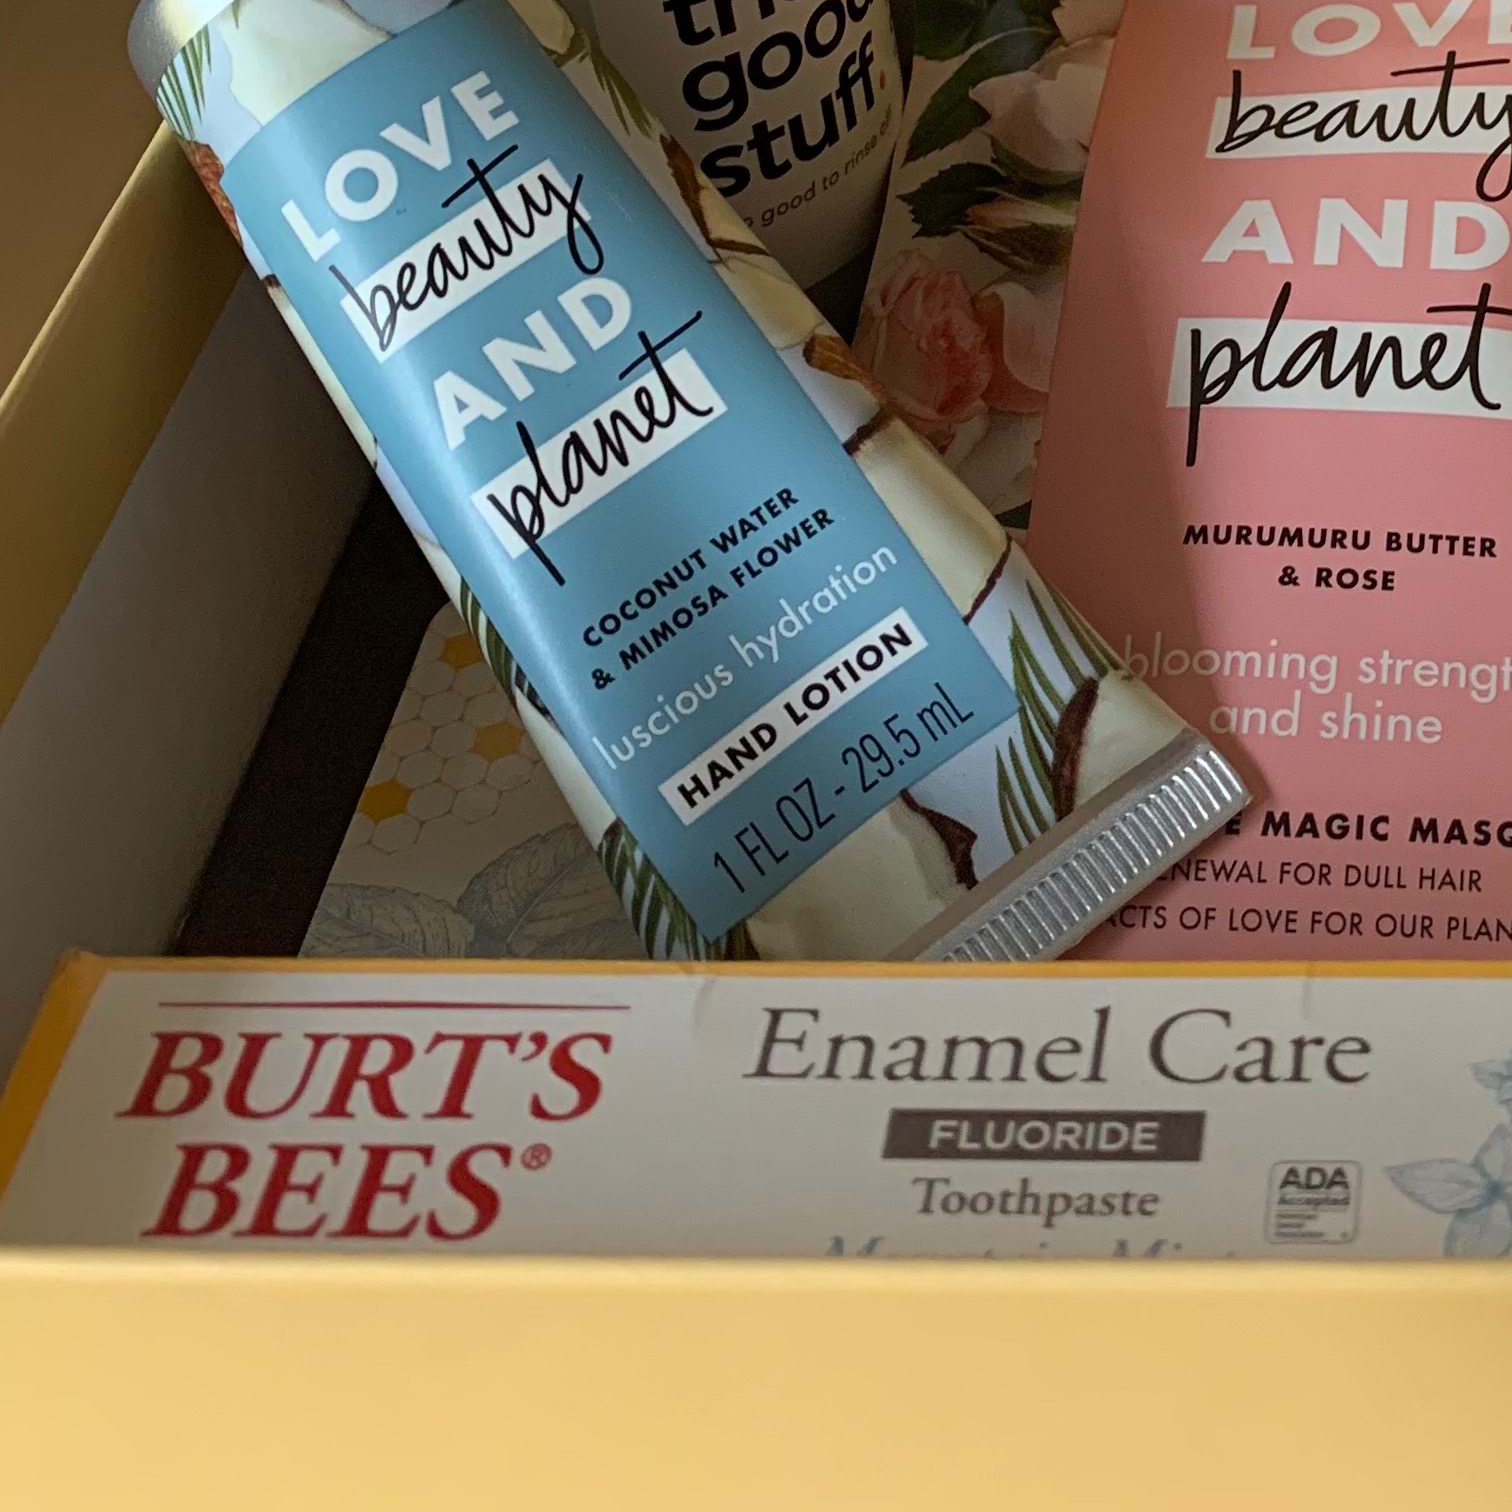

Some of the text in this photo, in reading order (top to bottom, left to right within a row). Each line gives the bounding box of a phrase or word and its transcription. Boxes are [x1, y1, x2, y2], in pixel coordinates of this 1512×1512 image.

[281, 71, 519, 262] LOVE
[761, 134, 878, 227] good to rinse
[329, 145, 603, 352] beauty
[1201, 197, 1511, 271] AND
[433, 276, 632, 451] AND
[487, 310, 714, 586] planet
[583, 488, 800, 647] COCONUT WATER
[1183, 524, 1498, 558] MURUMURU BUTTER
[1278, 565, 1396, 591] & ROSE
[590, 508, 835, 691] & MIMOSA FLOWER
[592, 545, 898, 770] luscious hydration
[1123, 631, 1337, 692] blooming
[677, 623, 913, 809] HAND LOTION
[1209, 691, 1442, 744] and shine
[713, 851, 745, 893] 1
[734, 822, 789, 877] FL
[775, 777, 836, 842] OZ
[842, 713, 921, 793] 29.5
[916, 682, 974, 742] mL
[1261, 810, 1390, 841] MAGIC
[1158, 859, 1483, 894] NEWAL FOR DULL HAIR
[1179, 906, 1217, 930] OF
[1228, 907, 1298, 934] LOVE
[1310, 910, 1363, 936] FOR
[1375, 913, 1434, 940] OUR
[113, 1030, 612, 1122] BURT'S
[743, 1005, 1371, 1084] Enamel Care
[929, 1119, 1158, 1153] FLUORIDE
[912, 1176, 1160, 1228] Toothpaste
[1279, 1167, 1350, 1189] ADA
